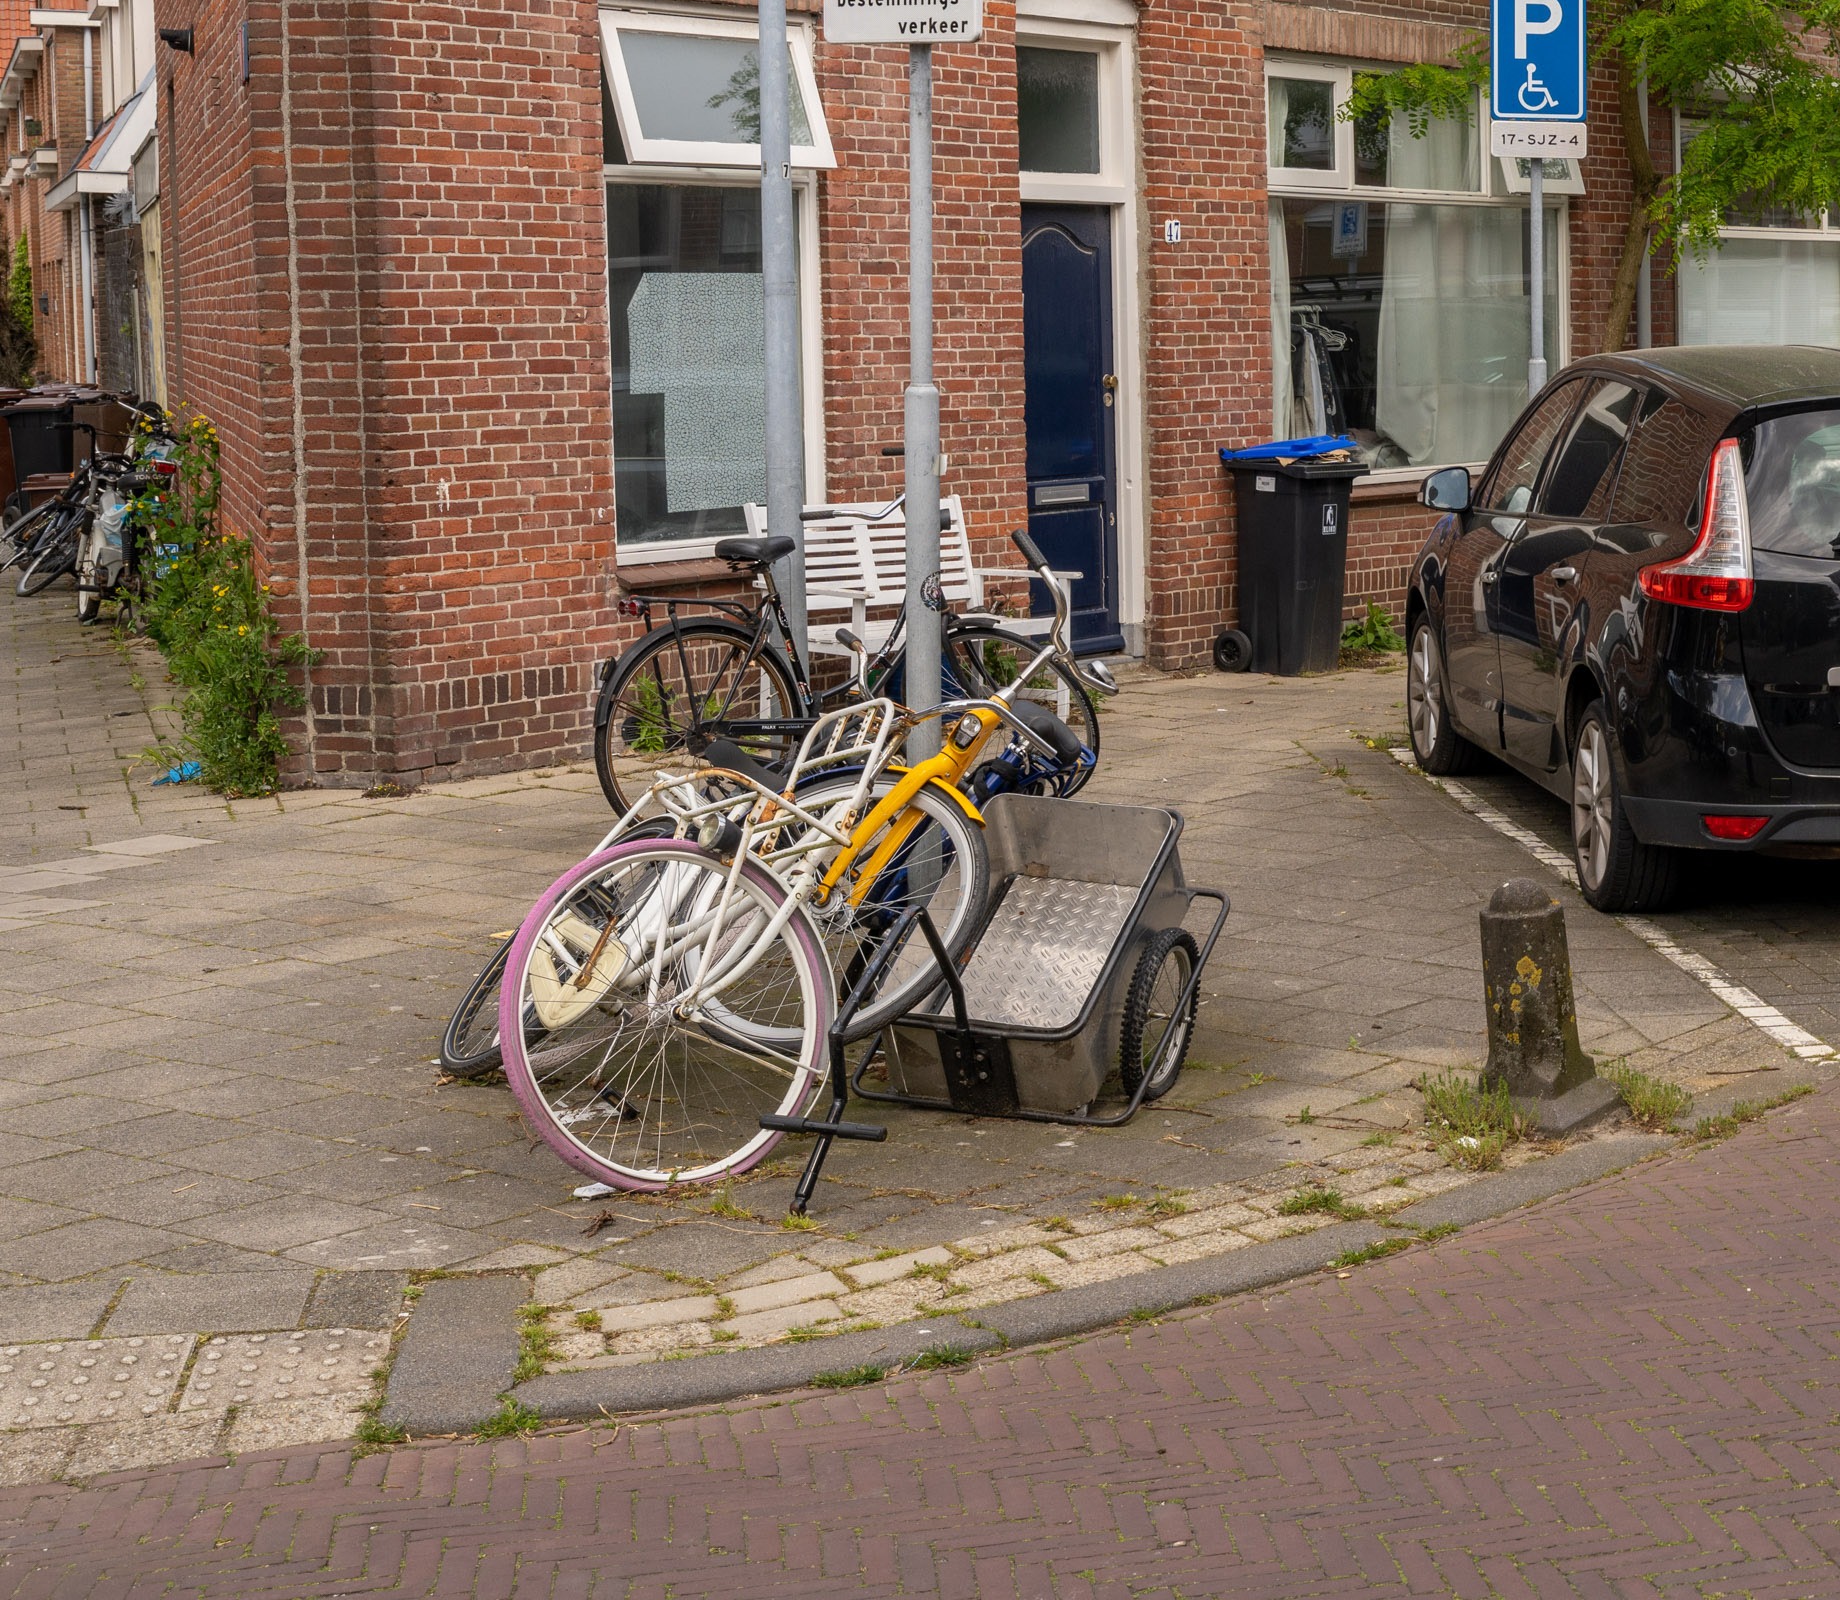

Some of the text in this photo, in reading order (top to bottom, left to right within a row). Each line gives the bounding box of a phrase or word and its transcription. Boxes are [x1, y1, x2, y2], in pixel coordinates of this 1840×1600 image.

[898, 17, 968, 34] verkeer
[1501, 133, 1579, 146] 17-SJZ-4
[783, 164, 789, 178] 7
[1167, 222, 1179, 241] 47
